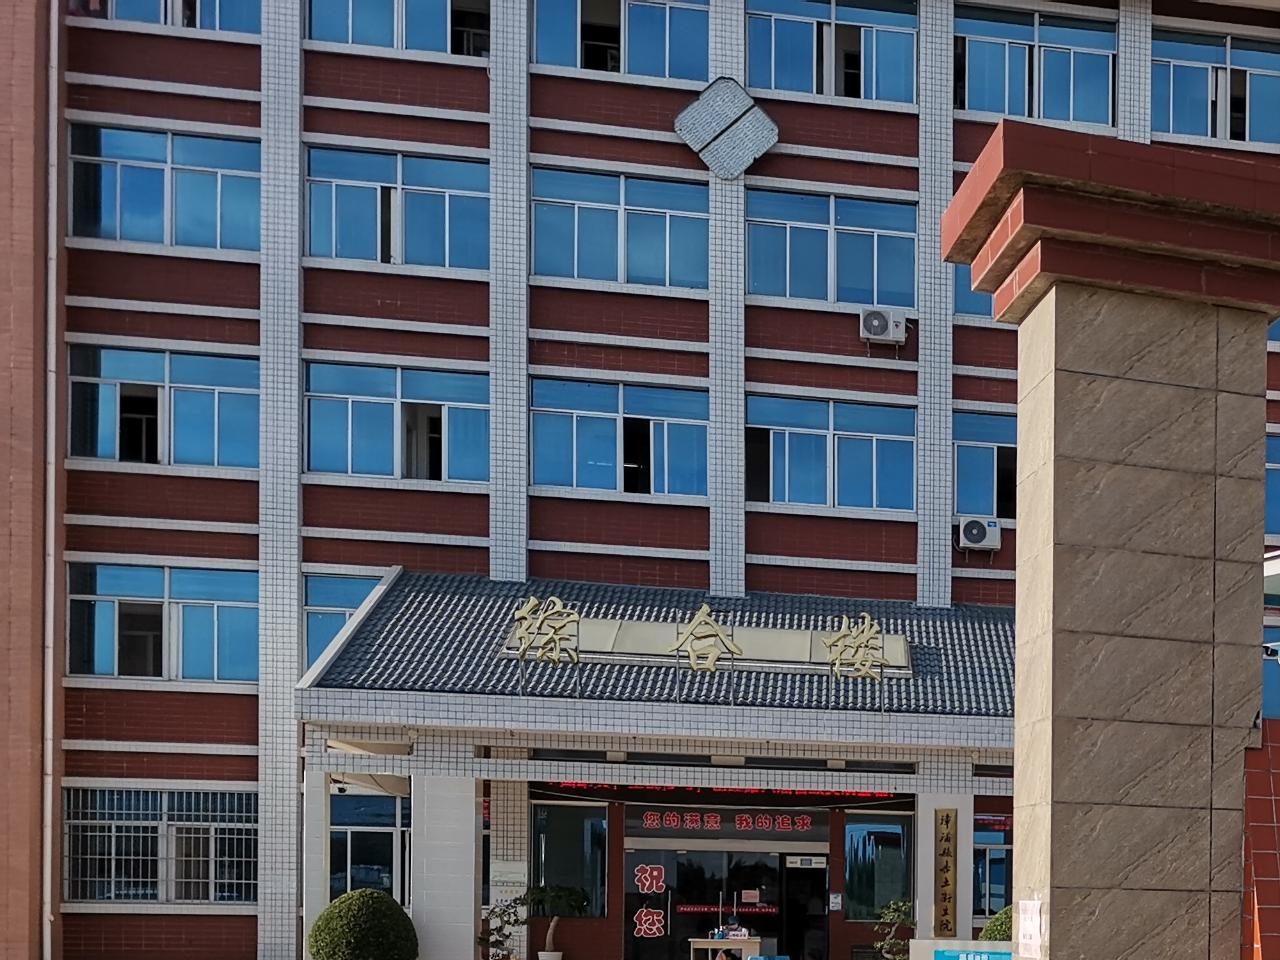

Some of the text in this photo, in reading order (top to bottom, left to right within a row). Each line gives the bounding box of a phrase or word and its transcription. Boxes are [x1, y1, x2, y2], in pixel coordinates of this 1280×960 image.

[642, 811, 813, 832] 您的满意 我的追求
